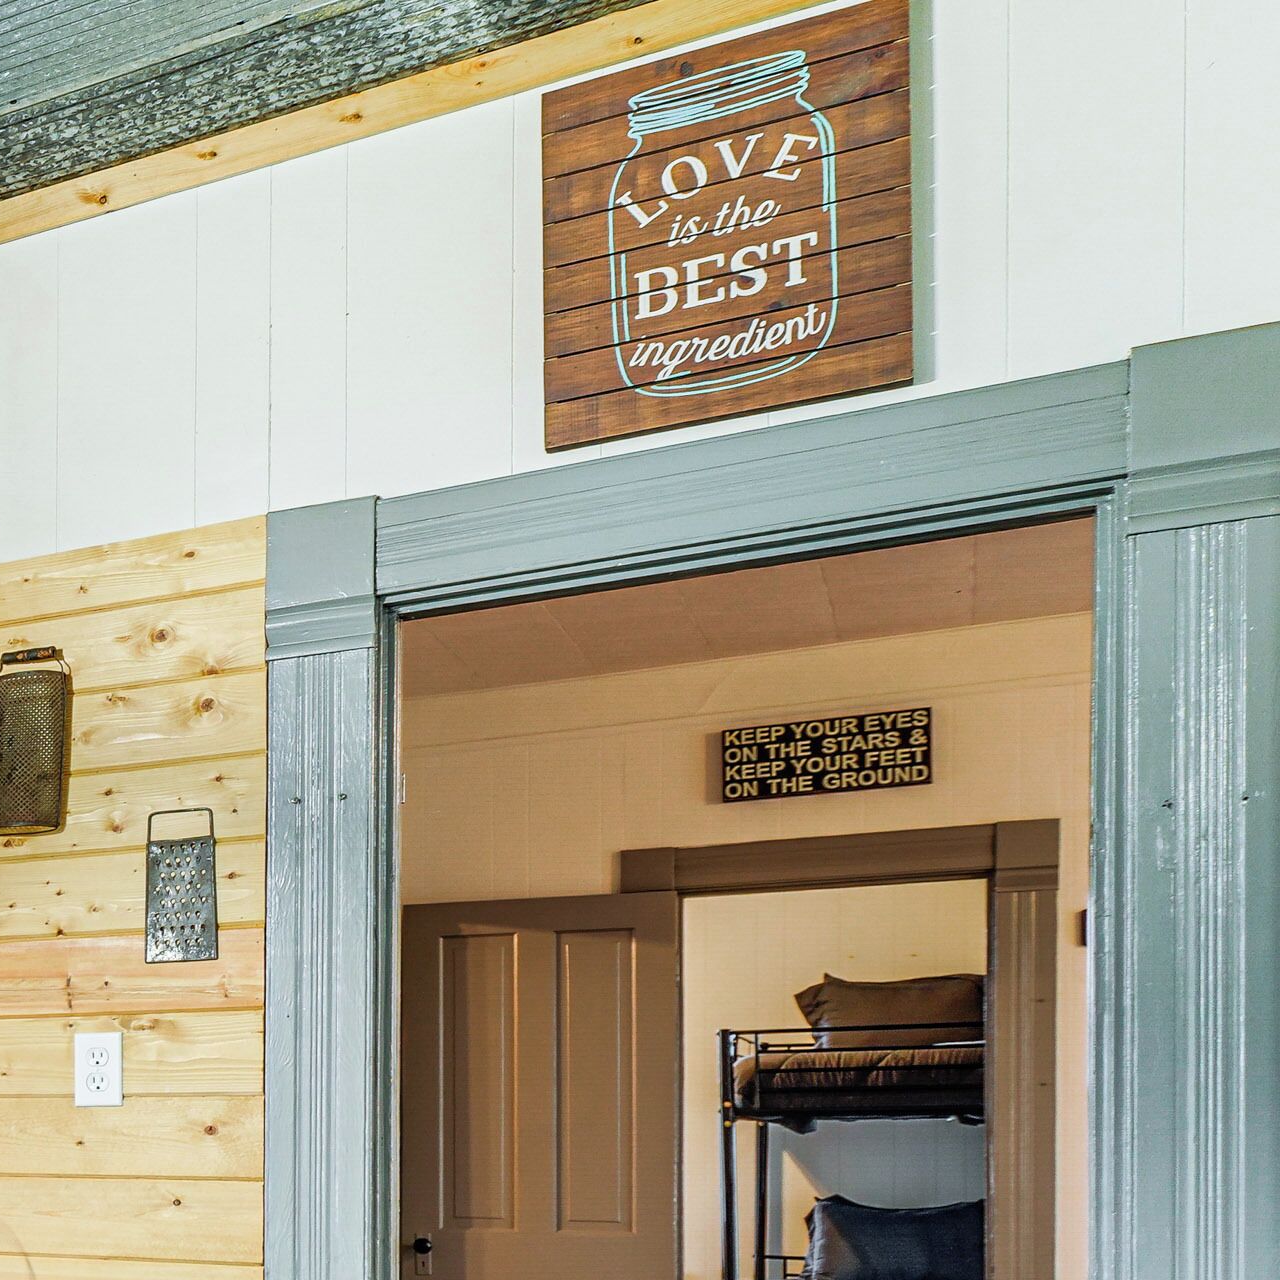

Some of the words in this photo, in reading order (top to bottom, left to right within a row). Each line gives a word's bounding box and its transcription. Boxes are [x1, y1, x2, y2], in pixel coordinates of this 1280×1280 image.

[615, 131, 819, 229] LOVE
[667, 213, 708, 248] is
[713, 194, 781, 239] the
[633, 230, 819, 321] BEST
[628, 302, 827, 382] ingredient
[724, 726, 785, 746] KEEP
[790, 718, 859, 739] YOUR
[863, 709, 929, 732] EYES
[724, 746, 758, 763] ON
[765, 740, 812, 760] THE
[821, 731, 902, 754] STARS
[908, 728, 928, 745] &
[724, 761, 786, 781] KEEP
[790, 753, 859, 775] YOUR
[864, 747, 928, 768] FEET
[724, 781, 759, 798] ON
[766, 775, 814, 794] THE
[822, 765, 929, 790] GROUND
